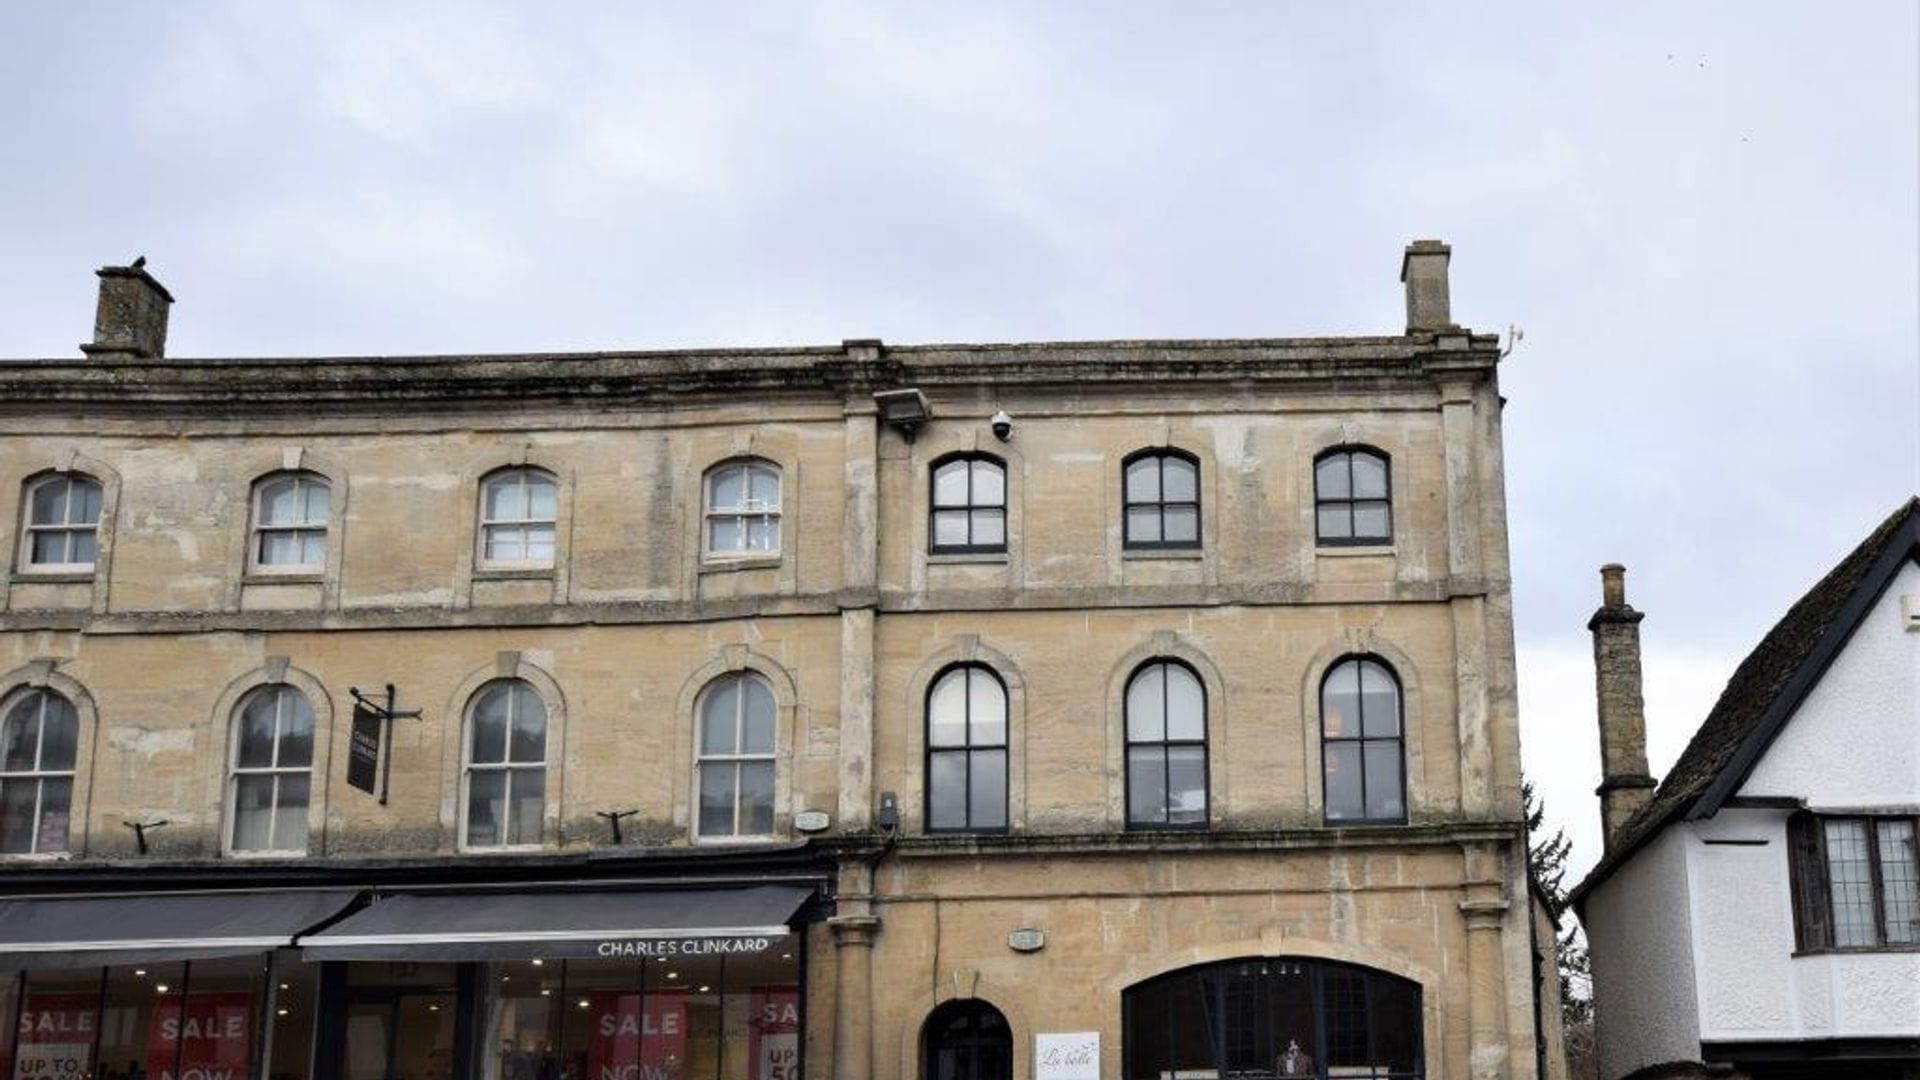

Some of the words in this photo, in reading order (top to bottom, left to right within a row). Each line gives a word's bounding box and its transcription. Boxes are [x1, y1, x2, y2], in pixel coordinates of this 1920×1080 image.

[598, 940, 677, 956] CHARLES
[682, 938, 769, 954] CLINKARD
[19, 1011, 93, 1033] SALE
[160, 1016, 243, 1040] SALE
[600, 1012, 679, 1037] SALE
[20, 1059, 45, 1073] UP
[53, 1058, 78, 1073] TO
[770, 1048, 794, 1063] UP
